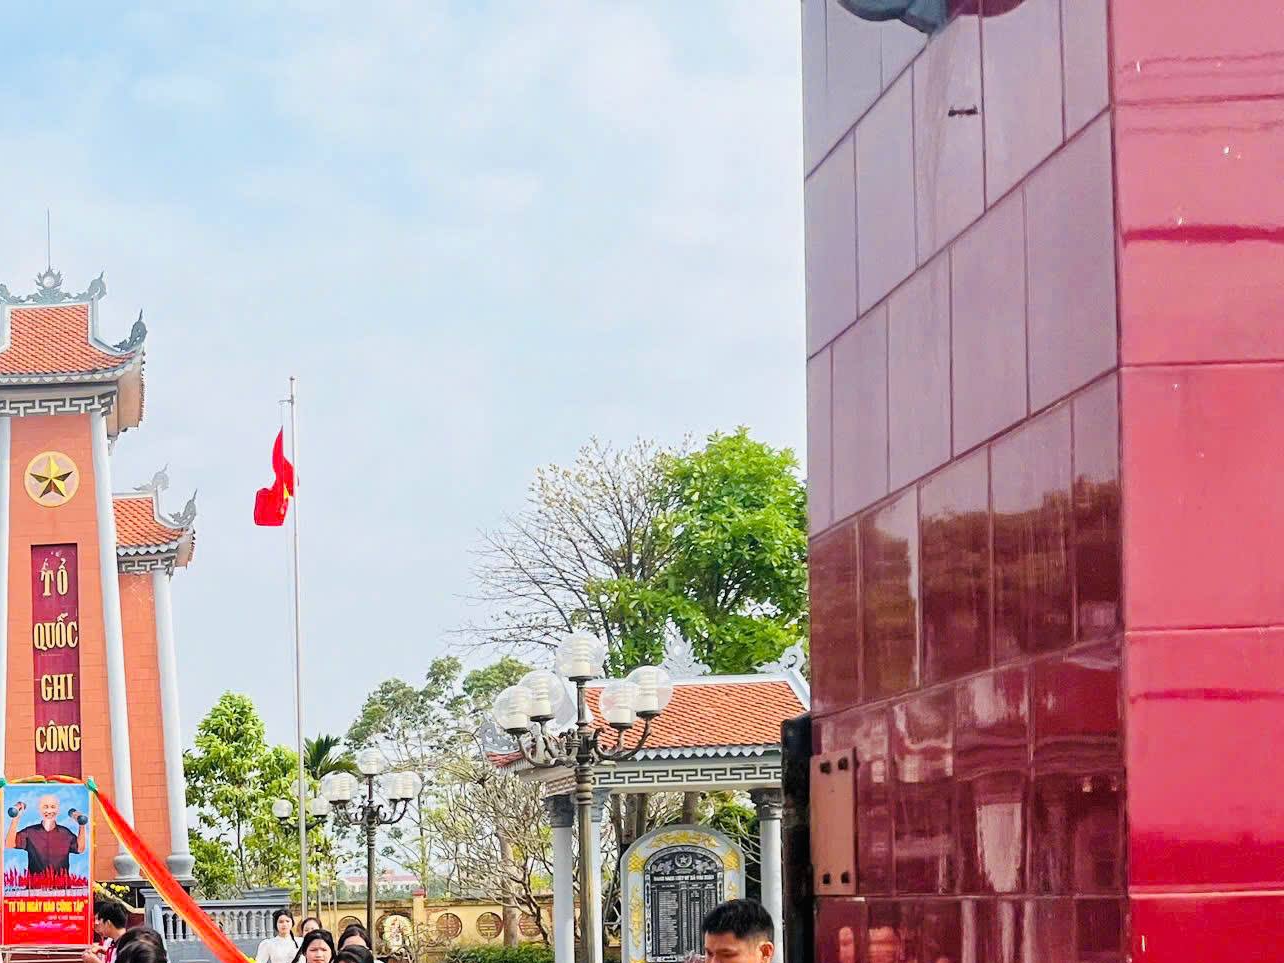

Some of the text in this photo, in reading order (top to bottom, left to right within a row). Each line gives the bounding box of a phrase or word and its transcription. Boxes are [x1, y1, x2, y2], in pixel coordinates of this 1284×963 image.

[40, 558, 68, 597] TỔ
[33, 612, 79, 651] QUỐC
[40, 673, 74, 701] GHI
[35, 719, 81, 753] CÔNG
